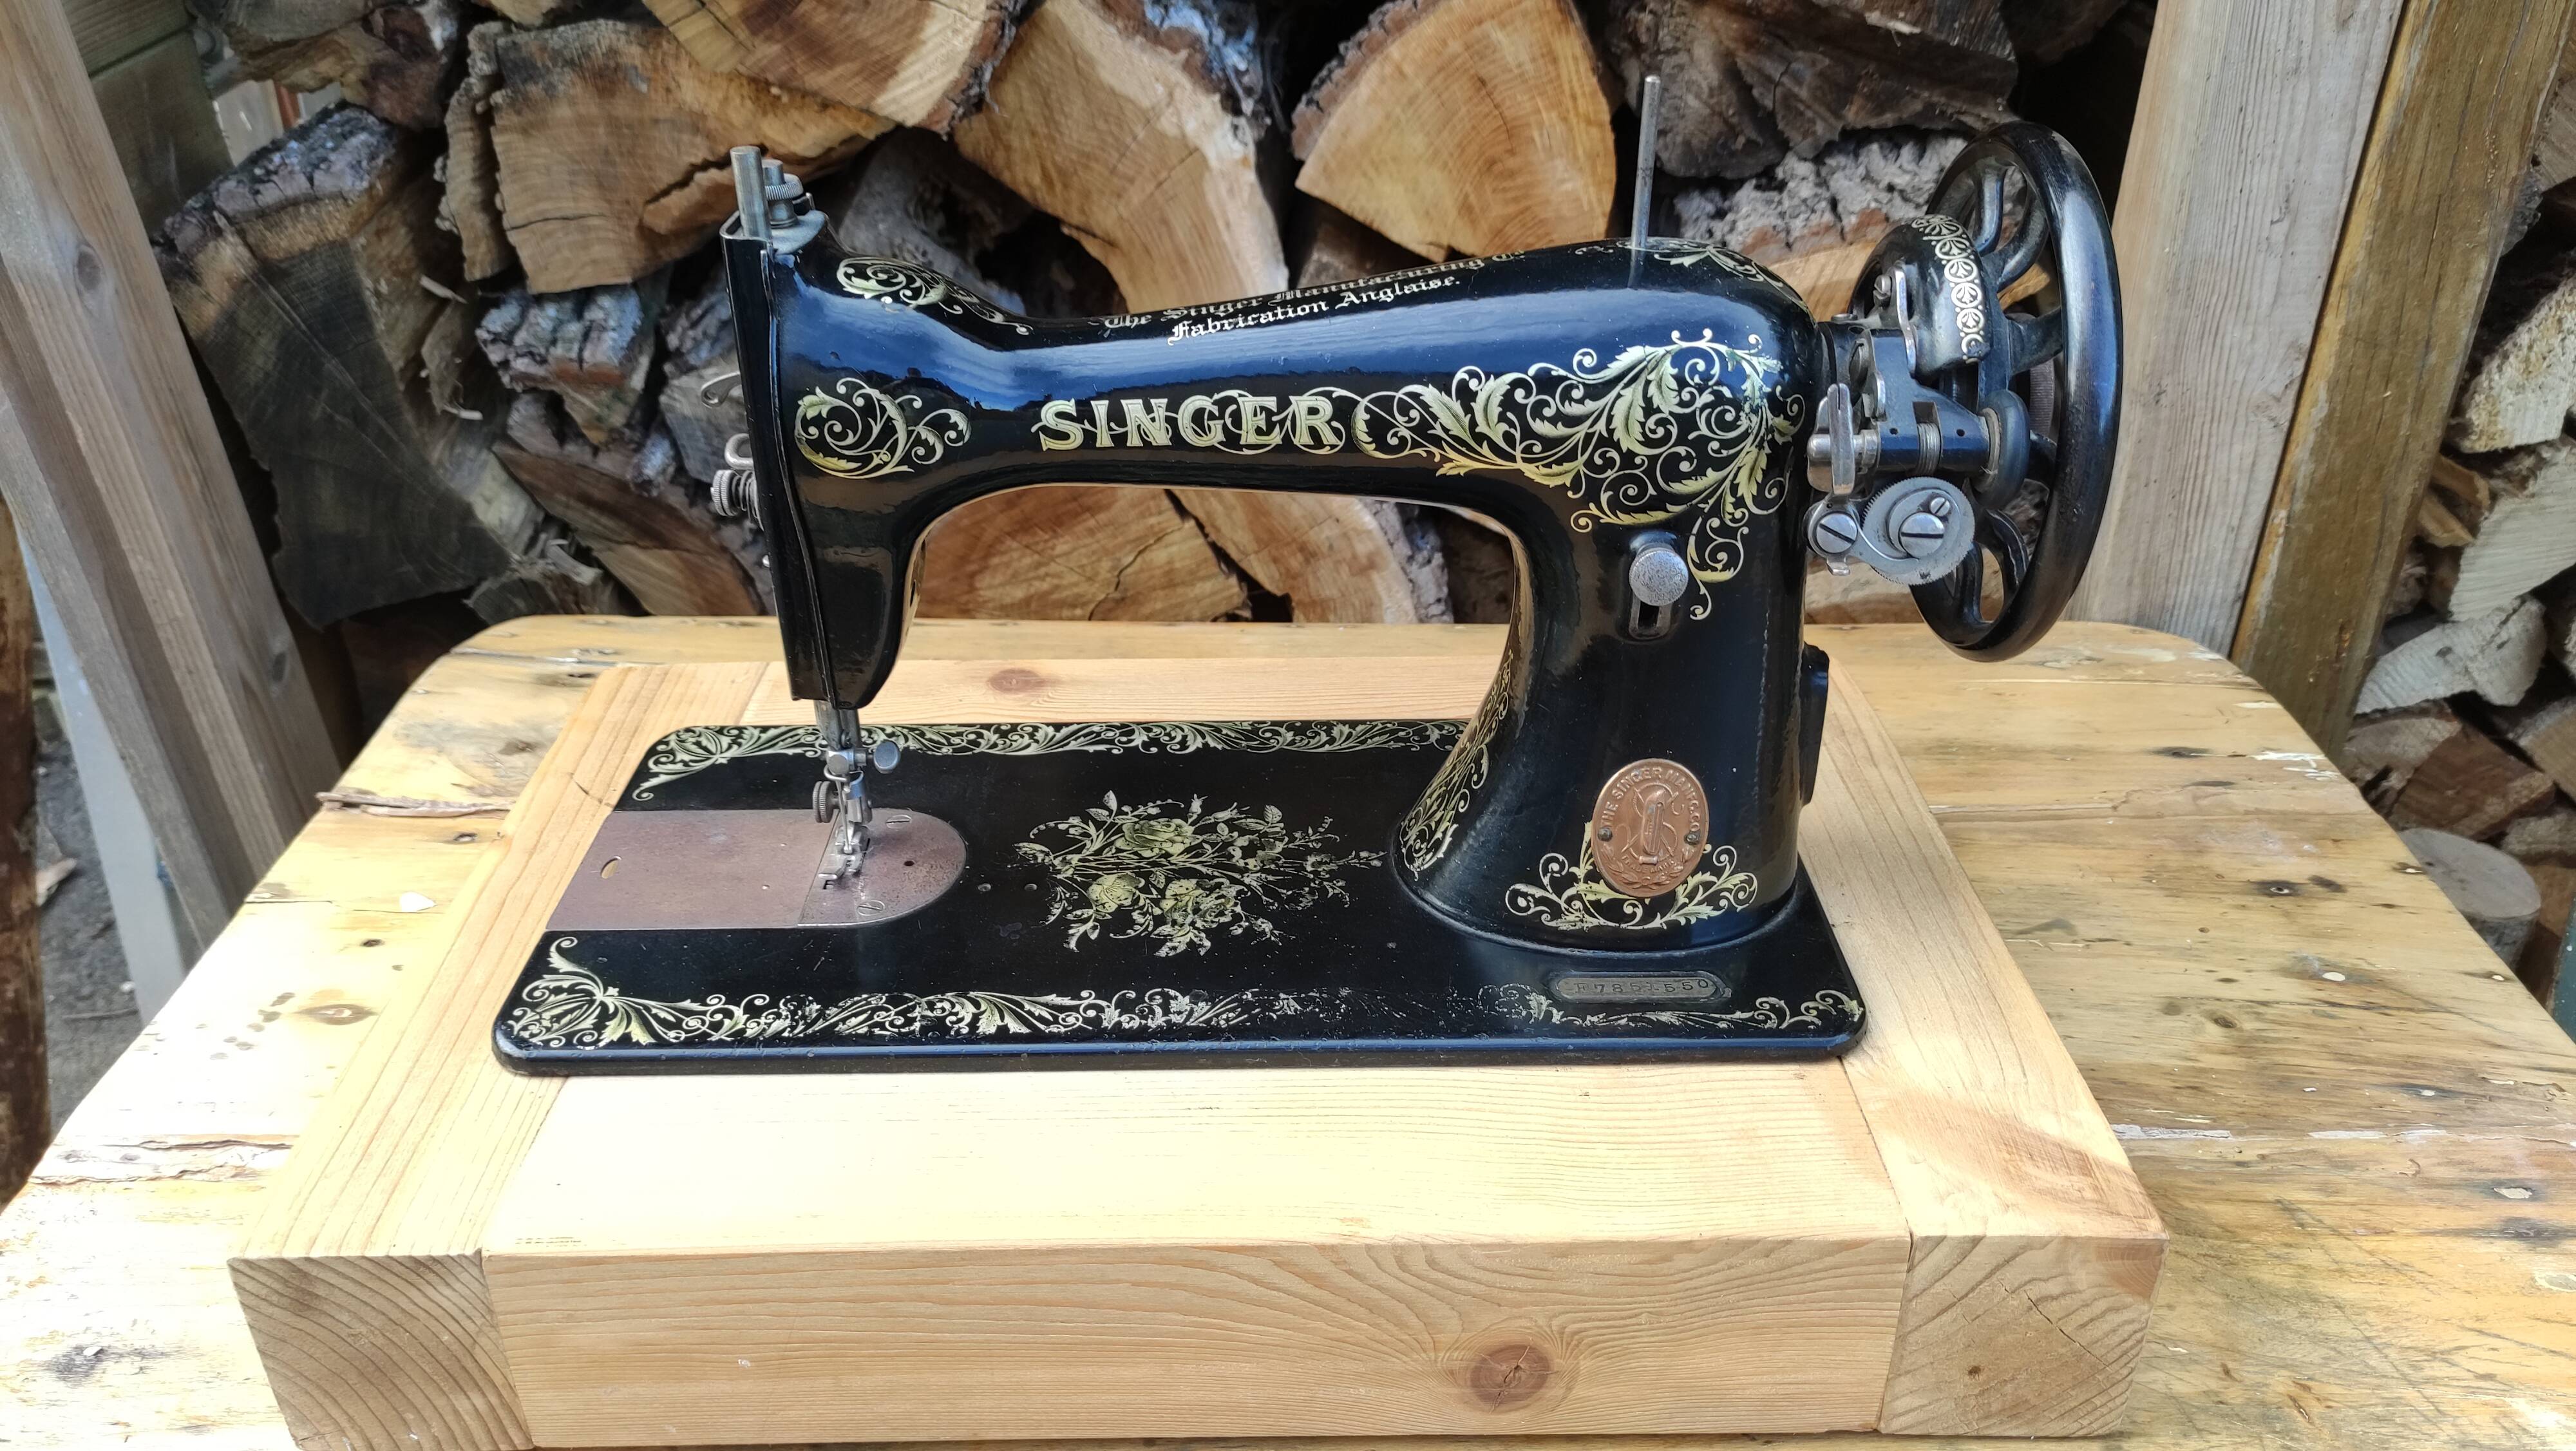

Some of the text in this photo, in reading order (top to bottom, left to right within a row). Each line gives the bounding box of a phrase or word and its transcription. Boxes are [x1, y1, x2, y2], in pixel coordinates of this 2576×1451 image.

[1168, 276, 1460, 346] Fabrication Anglaise.
[1038, 394, 1341, 451] SINGER
[1602, 801, 1619, 827] THE
[1612, 766, 1662, 799] SINGER
